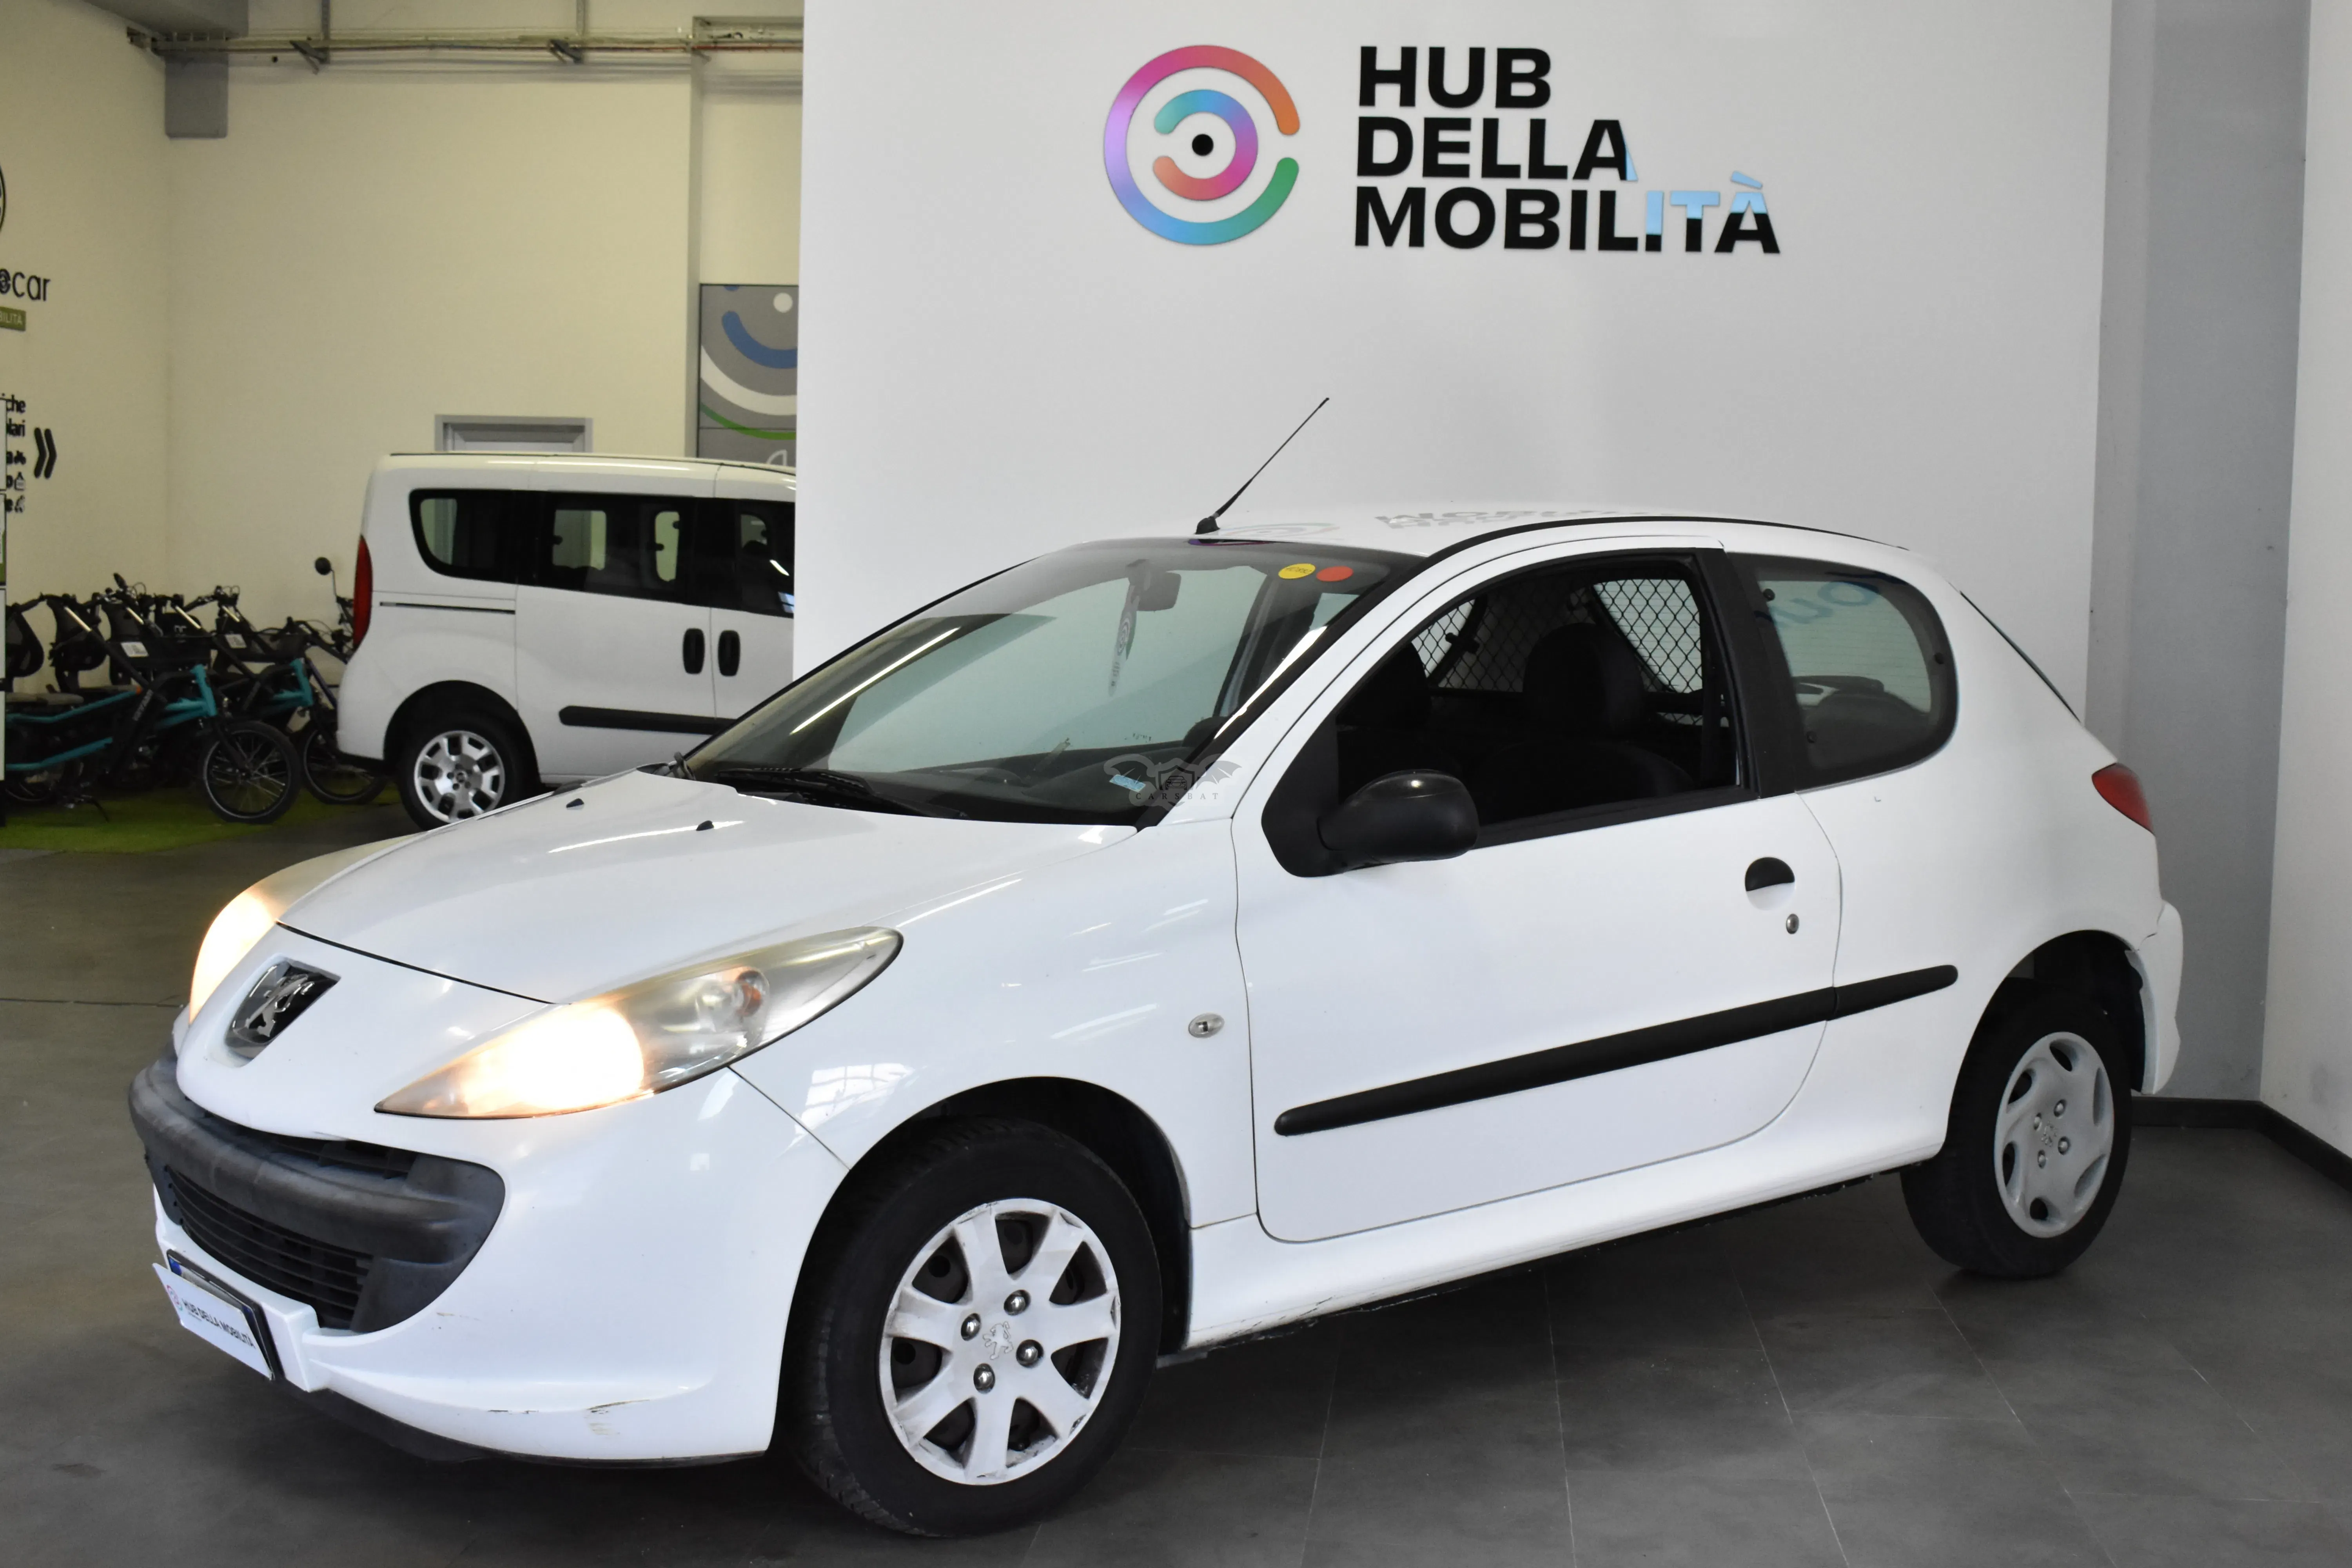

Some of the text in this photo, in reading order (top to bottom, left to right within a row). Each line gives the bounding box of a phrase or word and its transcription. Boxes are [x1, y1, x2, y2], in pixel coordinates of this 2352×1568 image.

[1359, 45, 1551, 109] HUB
[1356, 116, 1638, 181] DELLA
[1354, 172, 1781, 255] MOBILITÀ
